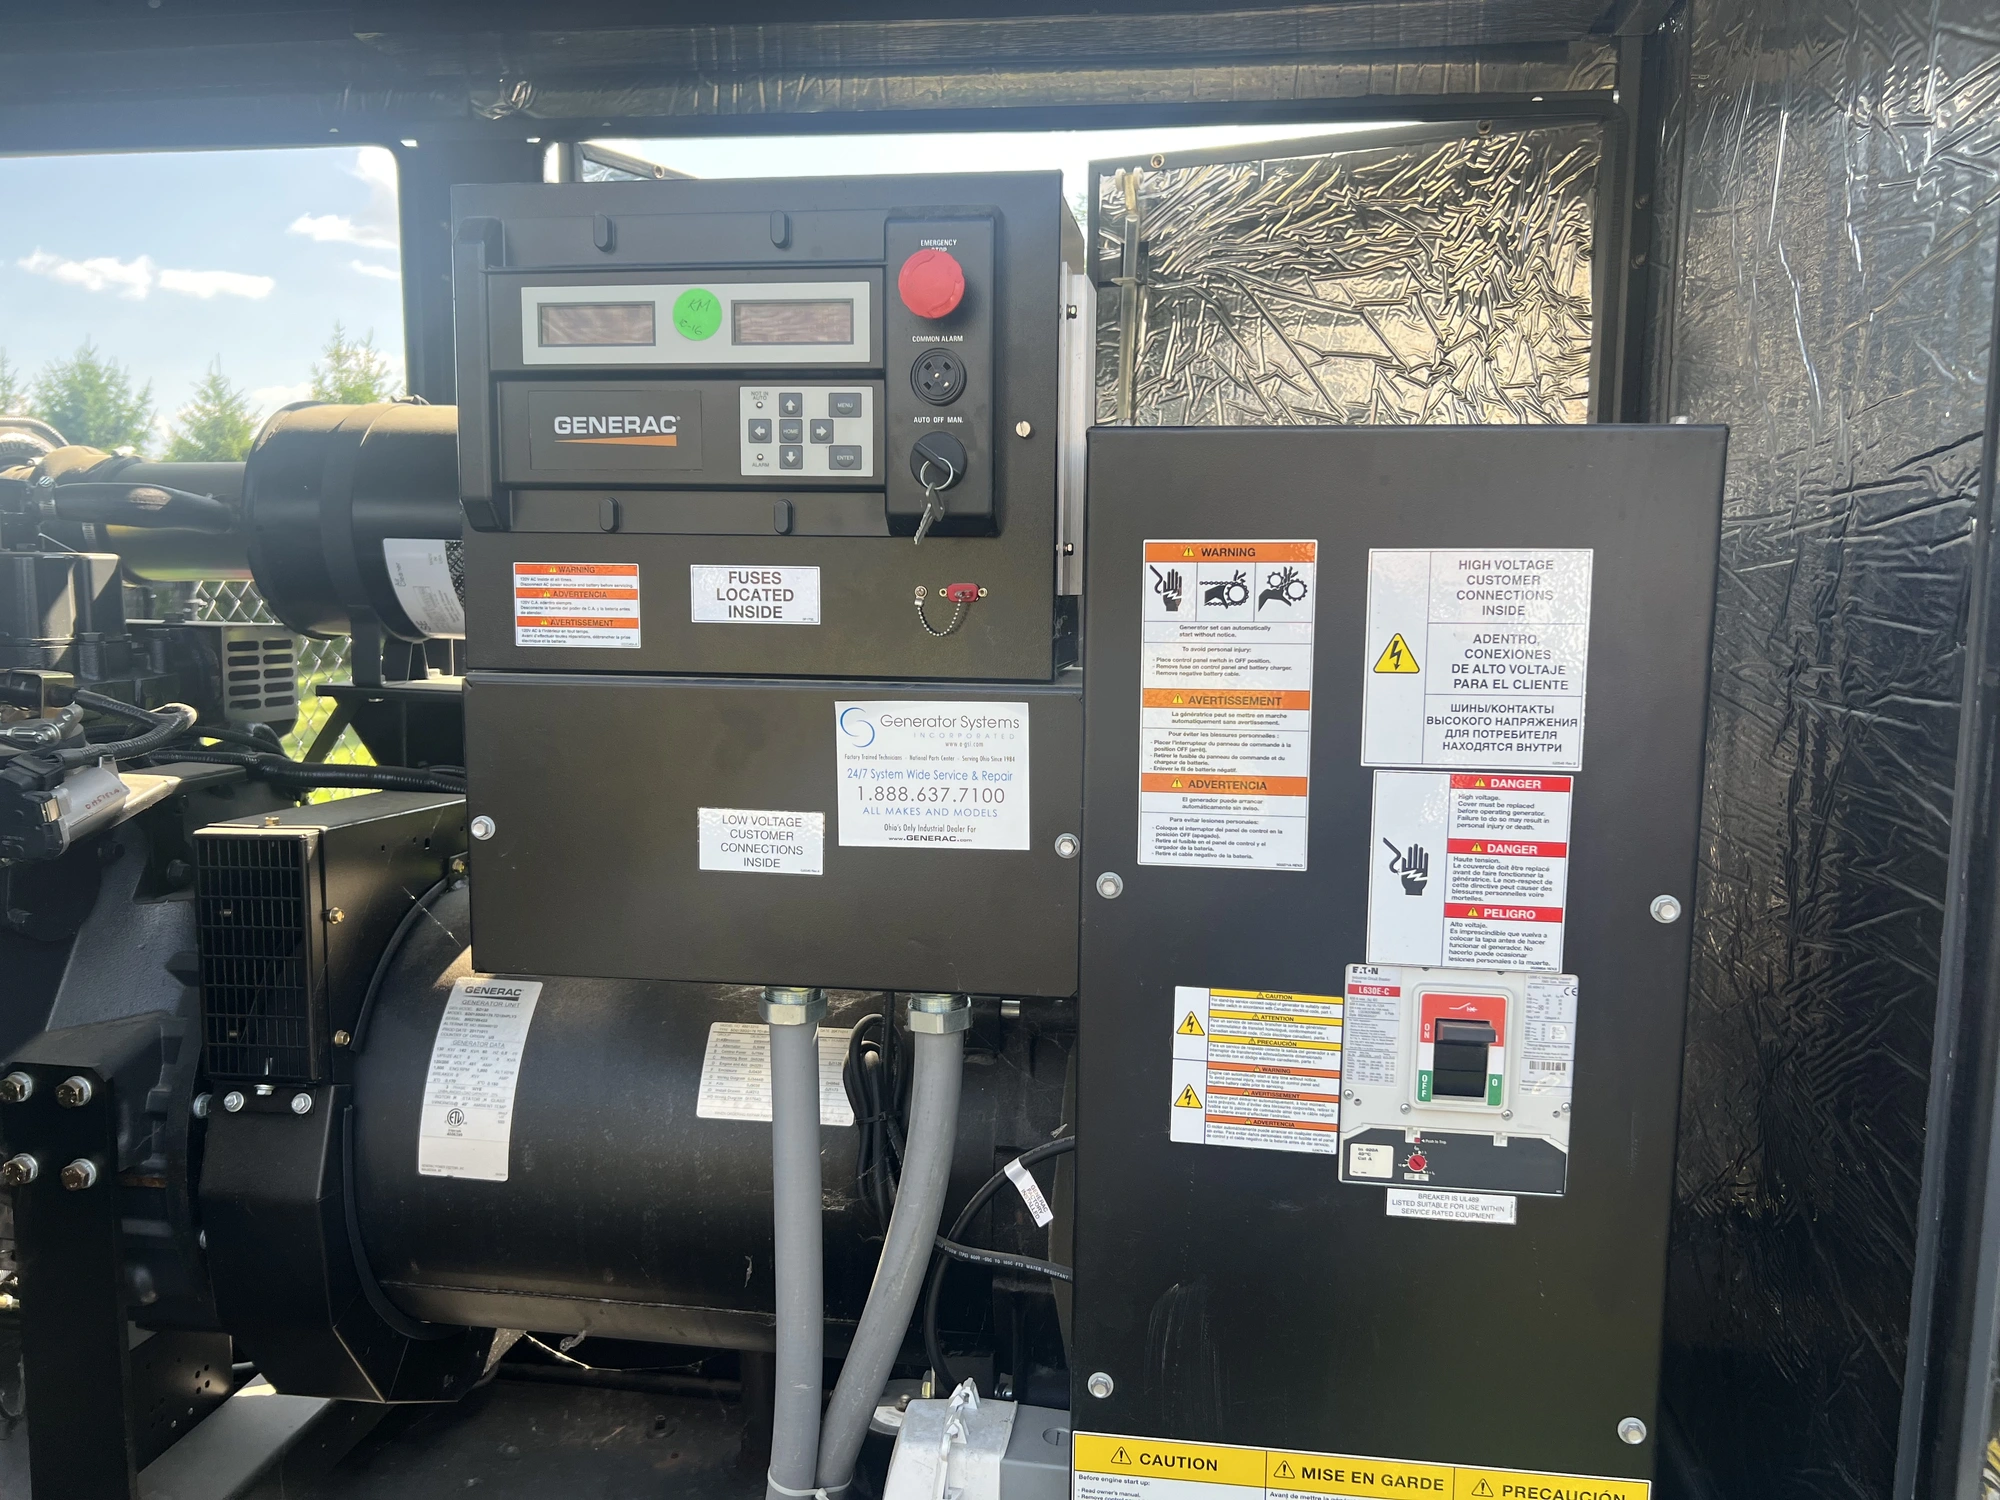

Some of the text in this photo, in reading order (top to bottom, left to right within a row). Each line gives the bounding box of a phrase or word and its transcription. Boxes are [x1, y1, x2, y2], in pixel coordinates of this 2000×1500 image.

[554, 415, 676, 436] GENERAC
[1201, 548, 1255, 557] WARNING
[1459, 560, 1553, 570] HIGH VOLTAGE
[729, 571, 781, 585] FUSES
[1466, 575, 1541, 585] CUSTOMER
[552, 591, 607, 599] ADVERTENCIA
[717, 588, 794, 602] LOCATED
[1456, 590, 1553, 601] CONNECTIONS
[728, 605, 782, 619] INSIDE
[1482, 606, 1525, 616] INSIDE
[1473, 634, 1539, 645] ADENTRO,
[1464, 650, 1551, 660] CONEXIONES
[1451, 664, 1565, 675] DE ALTO VOLTAJE
[1454, 679, 1568, 690] PARA EL CLIENTE
[1188, 697, 1282, 706] AVERTISSEMENT
[1451, 704, 1554, 714] ШИНЫ/КОНТАКТЫ
[880, 714, 1019, 731] Generator Systems
[1426, 716, 1577, 727] ВЫСОКОГО НАПРЯЖЕНИЯ
[913, 732, 1015, 740] INCORPORATED
[1445, 730, 1557, 740] ДЛЯ ПОТРЕБИТЕЛЯ
[1442, 742, 1562, 752] НАХОДЯТСЯ ВНУТРИ
[962, 755, 978, 763] Serving
[847, 768, 1012, 783] 24/7 System Wide Service & Repair
[1188, 780, 1267, 790] ADVERTENCIA
[1491, 779, 1541, 789] DANGER
[858, 785, 1004, 803] 1.888.637.7100
[1475, 794, 1500, 802] voltage.
[1457, 801, 1477, 809] Cover
[862, 807, 997, 818] ALL MAKES AND MODELS
[1457, 808, 1478, 816] before
[722, 815, 802, 828] LOW VOLTAGE
[884, 824, 901, 832] Ohio's
[903, 824, 916, 833] Only
[946, 825, 965, 833] Dealer
[967, 825, 976, 833] For
[730, 829, 794, 841] CUSTOMER
[889, 834, 972, 842] www.GENERAC.com
[720, 842, 803, 855] CONNECTIONS
[1487, 844, 1537, 855] DANGER
[744, 858, 780, 868] INSIDE
[1484, 908, 1536, 919] PELIGRO
[465, 986, 522, 996] GENERAC
[1359, 986, 1389, 996] L630E-C
[1424, 1023, 1430, 1039] ON
[451, 1040, 489, 1048] GENERATOR
[1250, 1090, 1300, 1099] AVERTISSEMENT
[1252, 1119, 1295, 1128] ADVERTENCIA
[1418, 1193, 1450, 1201] BREAKER
[1392, 1200, 1415, 1209] LISTED
[1416, 1201, 1448, 1209] SUITABLE
[1455, 1211, 1495, 1220] EQUIPMENT
[1140, 1453, 1217, 1471] CAUTION
[1101, 1476, 1122, 1484] engine
[1302, 1467, 1374, 1485] MISE EN
[1381, 1474, 1444, 1491] GARDE
